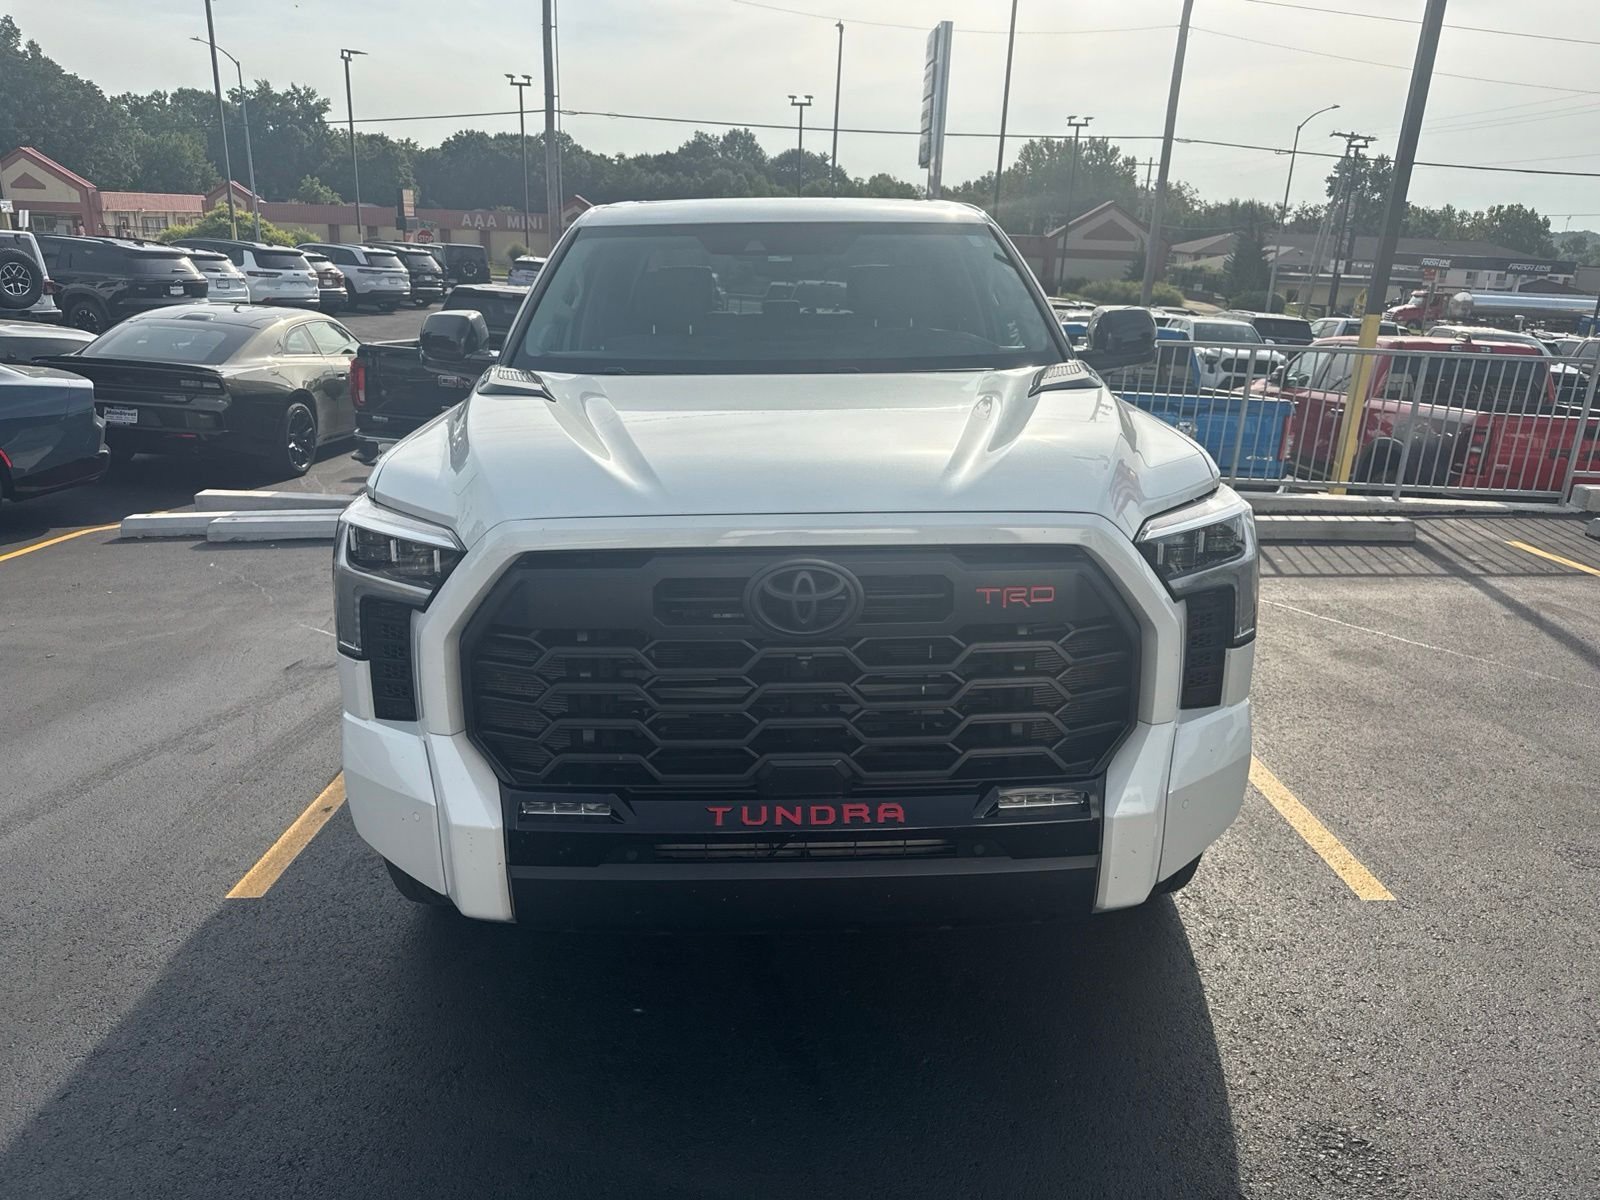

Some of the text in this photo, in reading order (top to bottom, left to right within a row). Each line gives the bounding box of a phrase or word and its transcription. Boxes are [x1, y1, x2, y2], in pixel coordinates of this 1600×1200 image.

[461, 214, 543, 230] AAA MINI
[418, 234, 433, 242] STOP
[1421, 257, 1440, 267] FINISH
[1439, 259, 1451, 268] LINE
[1508, 263, 1535, 271] FINISH
[437, 374, 475, 389] GM
[975, 586, 1055, 608] TRD
[706, 802, 906, 826] TUNDRA
